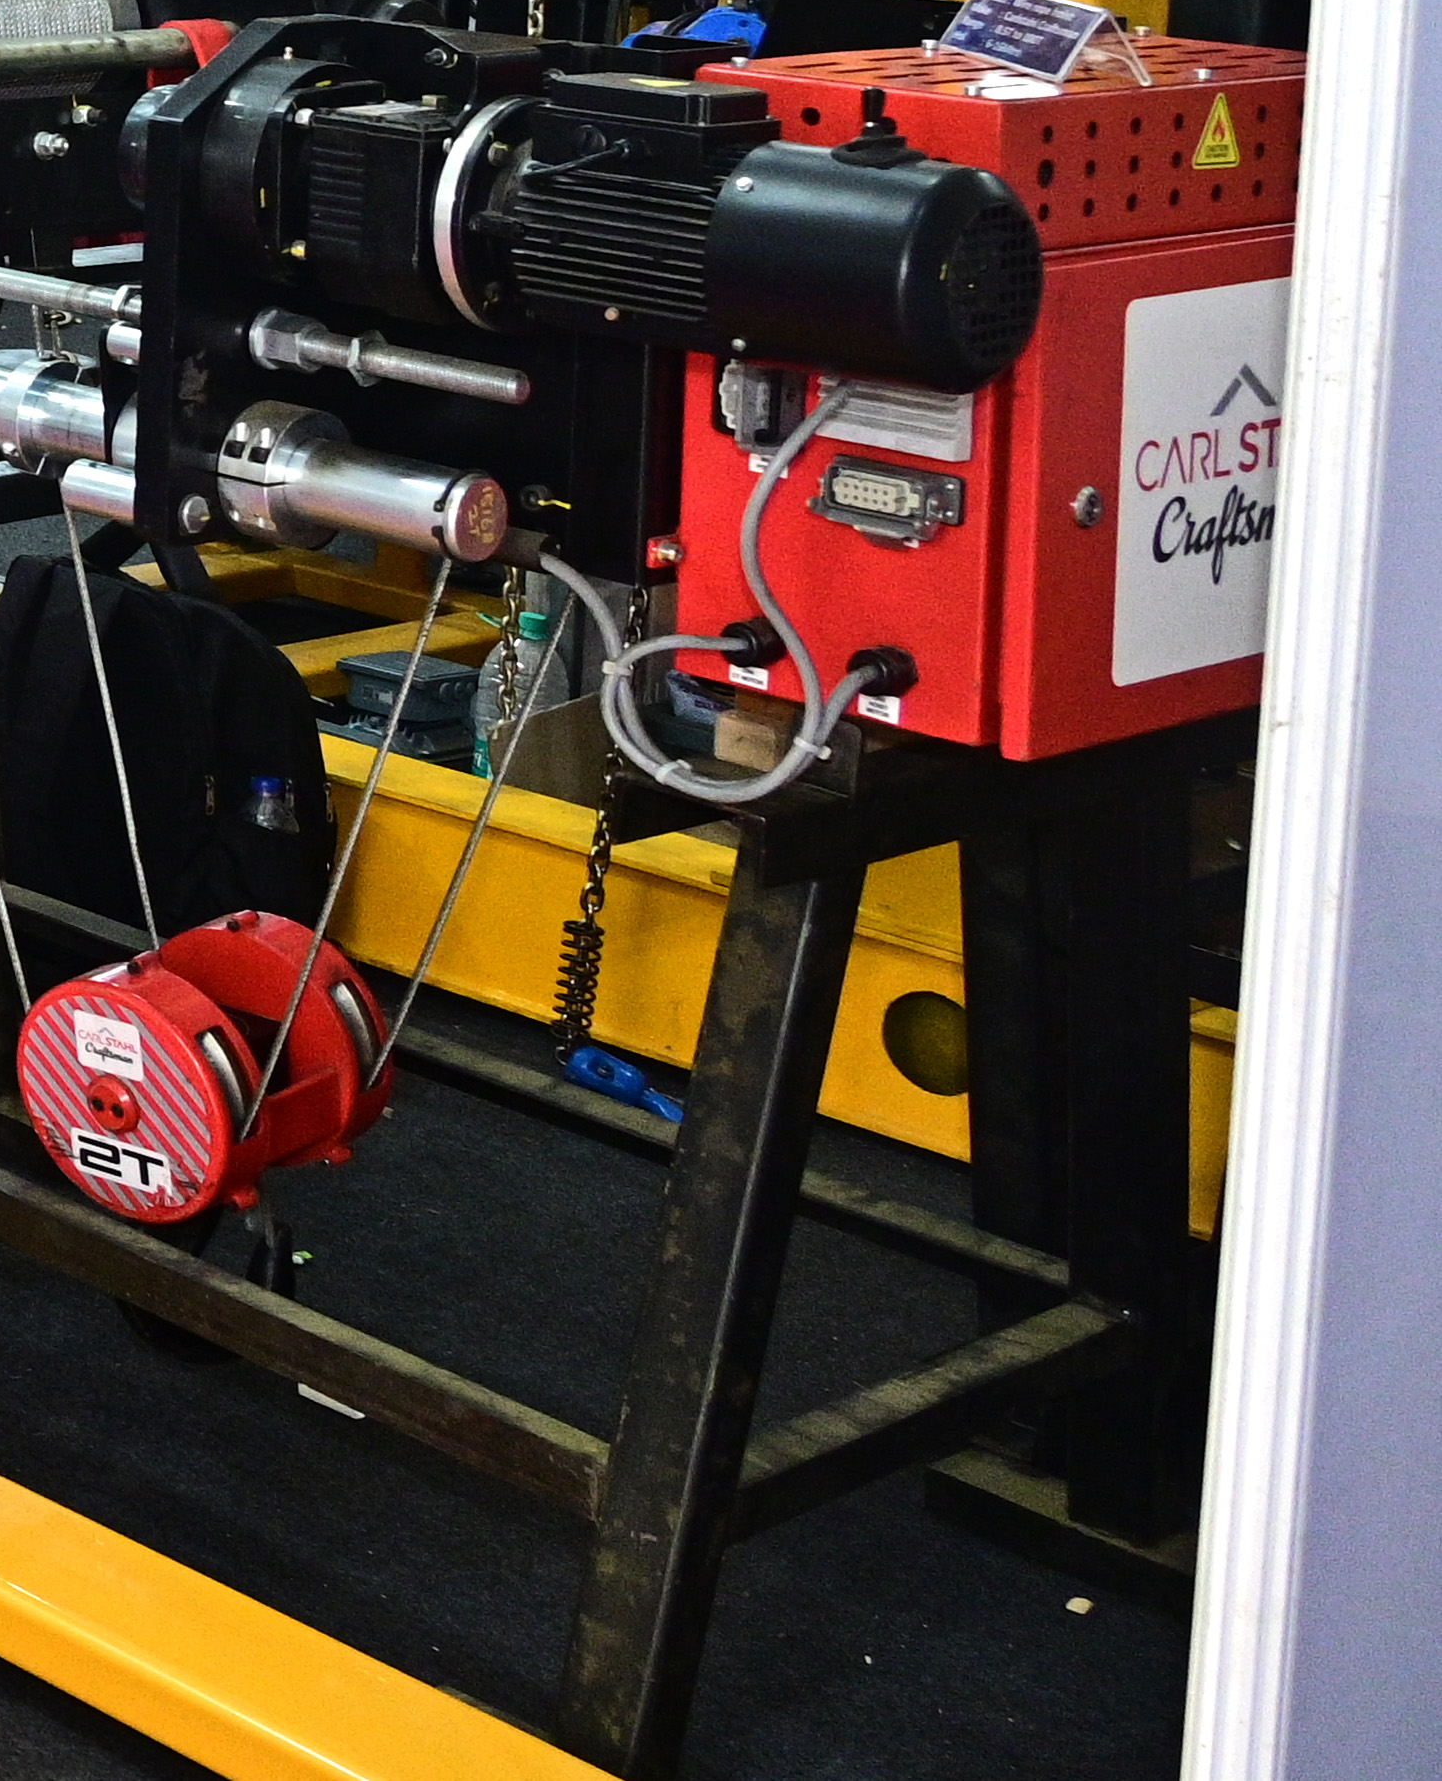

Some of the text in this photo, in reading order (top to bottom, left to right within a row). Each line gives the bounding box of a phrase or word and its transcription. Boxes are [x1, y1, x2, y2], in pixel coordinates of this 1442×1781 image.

[1135, 429, 1231, 491] CARL
[1152, 484, 1276, 585] Craftsm
[78, 1029, 138, 1054] CARL STAHL
[85, 1042, 133, 1064] Craftsman
[78, 1135, 164, 1186] 2T
